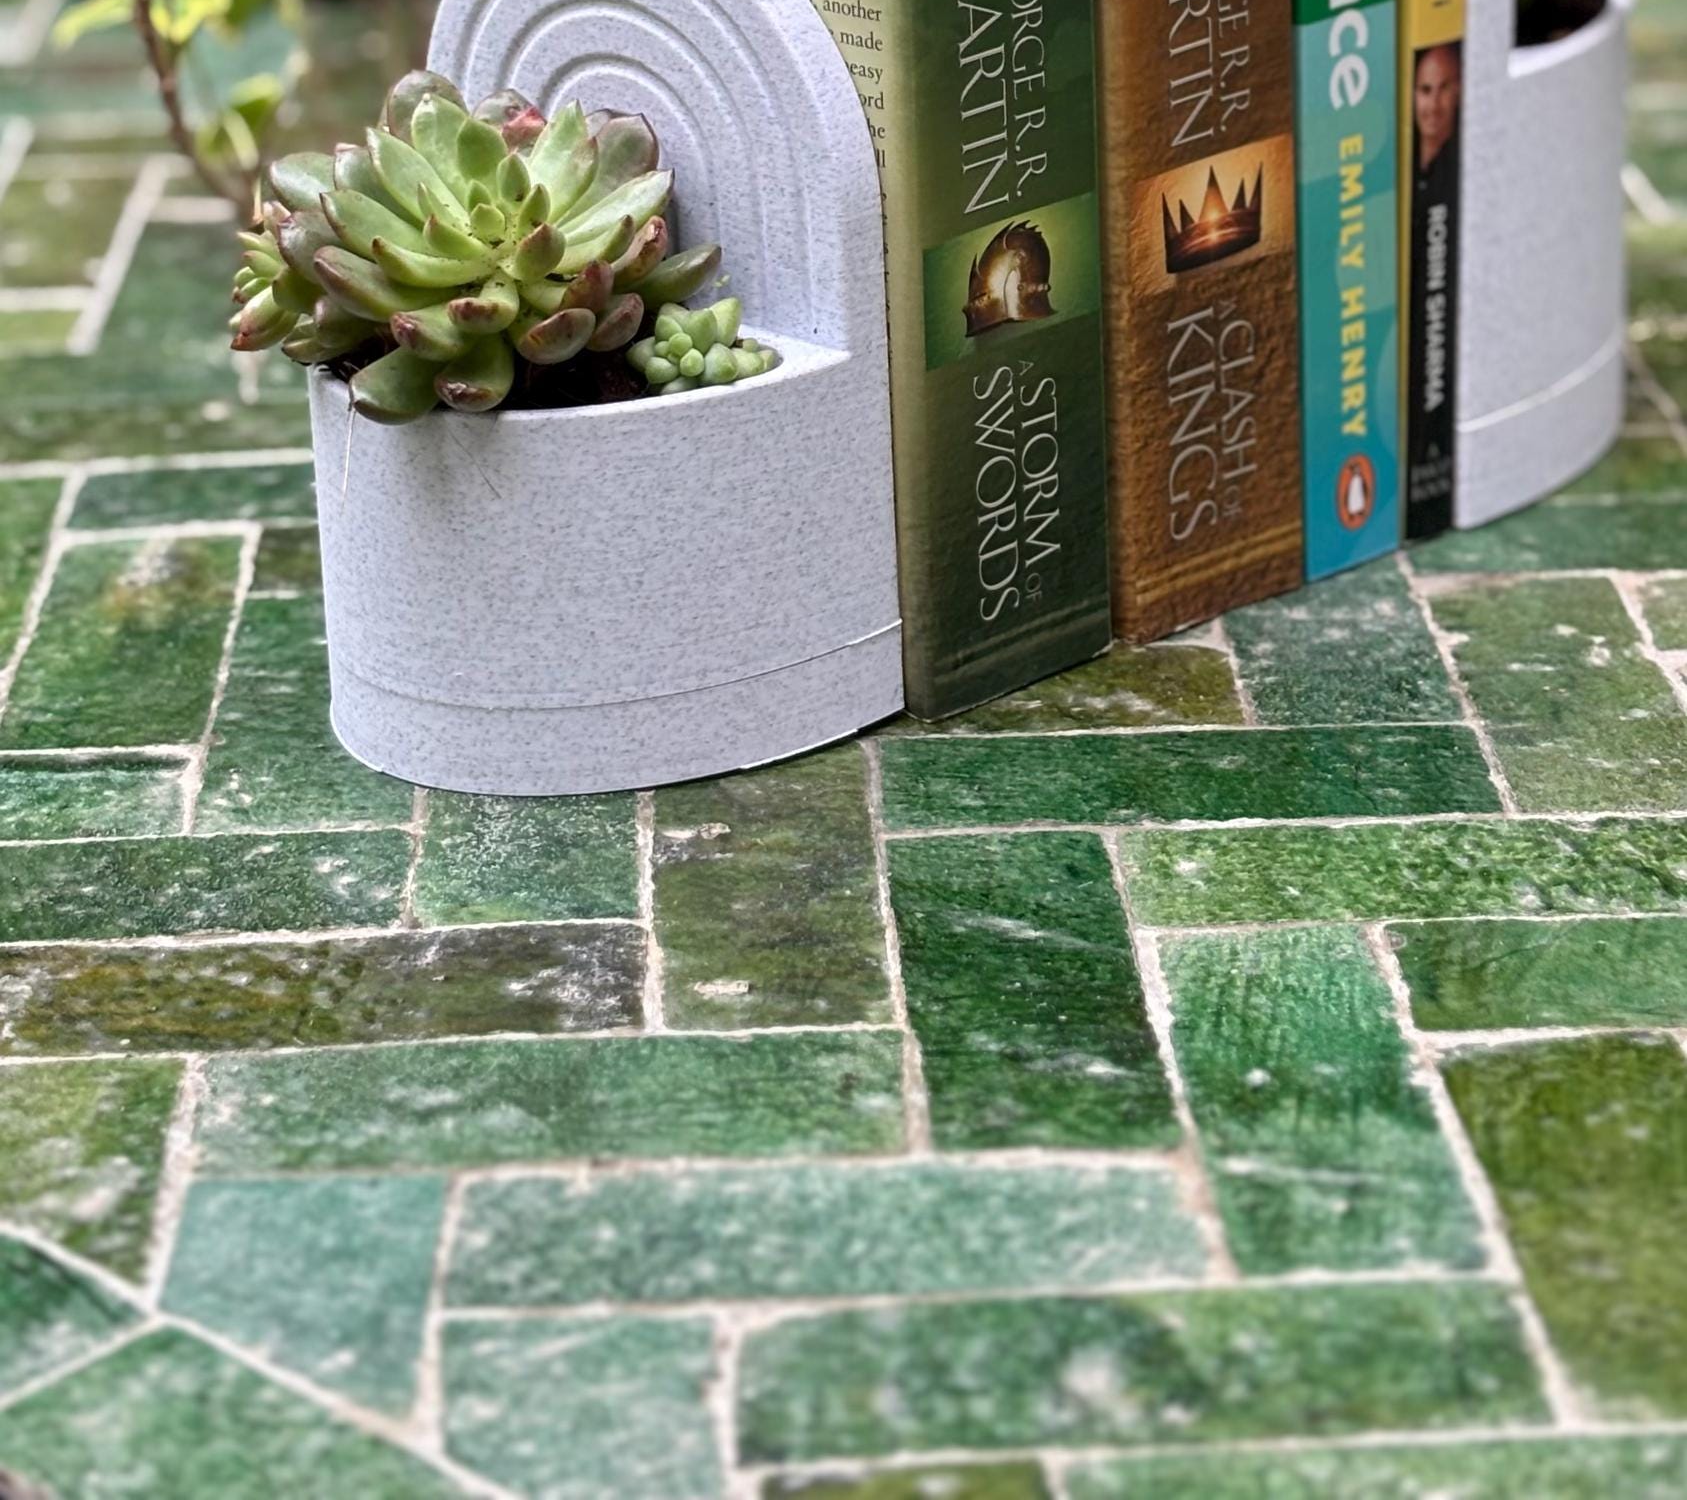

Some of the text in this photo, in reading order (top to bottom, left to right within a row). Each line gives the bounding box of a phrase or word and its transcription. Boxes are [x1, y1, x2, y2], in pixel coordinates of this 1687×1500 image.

[823, 0, 882, 21] another
[840, 31, 883, 52] made
[1339, 135, 1366, 437] EMILY HENRY
[1424, 204, 1447, 413] ROBIN SHARMA
[972, 365, 1020, 622] SWORDS
[1017, 359, 1061, 602] A STORM OF
[1166, 306, 1219, 542] KINGS
[1217, 297, 1257, 517] A CLASH OF
